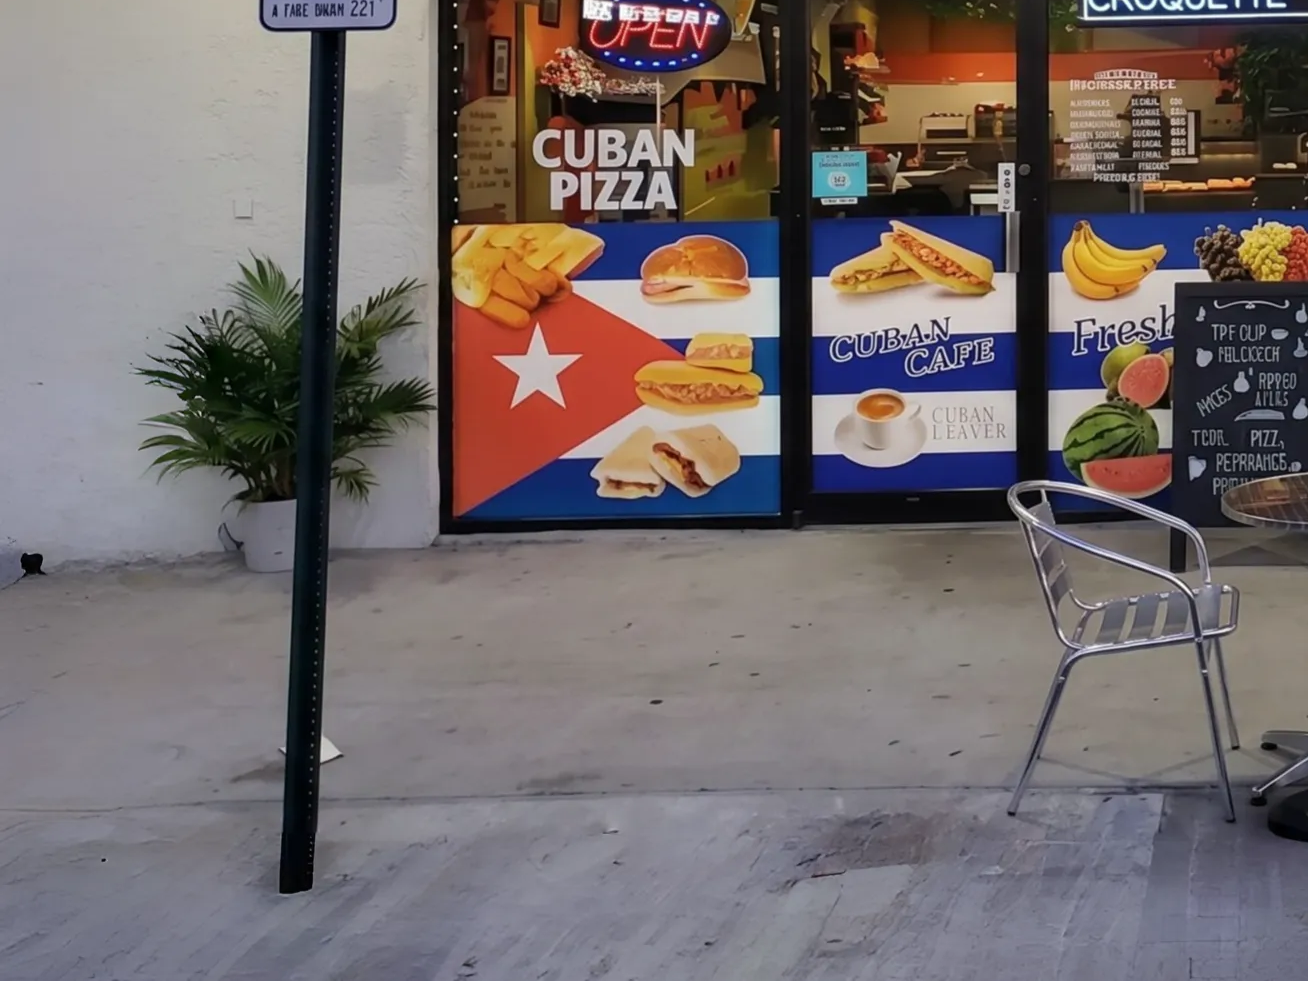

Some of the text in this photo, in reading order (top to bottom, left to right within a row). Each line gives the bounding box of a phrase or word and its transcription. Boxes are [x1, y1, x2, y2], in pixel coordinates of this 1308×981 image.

[532, 128, 696, 168] CUBAN
[550, 171, 678, 211] PIZZA
[829, 316, 952, 363] CUBAN
[1071, 304, 1175, 356] Fresh
[904, 337, 995, 378] CAFE
[932, 405, 995, 424] CUBAN
[932, 422, 1007, 441] LEAVER
